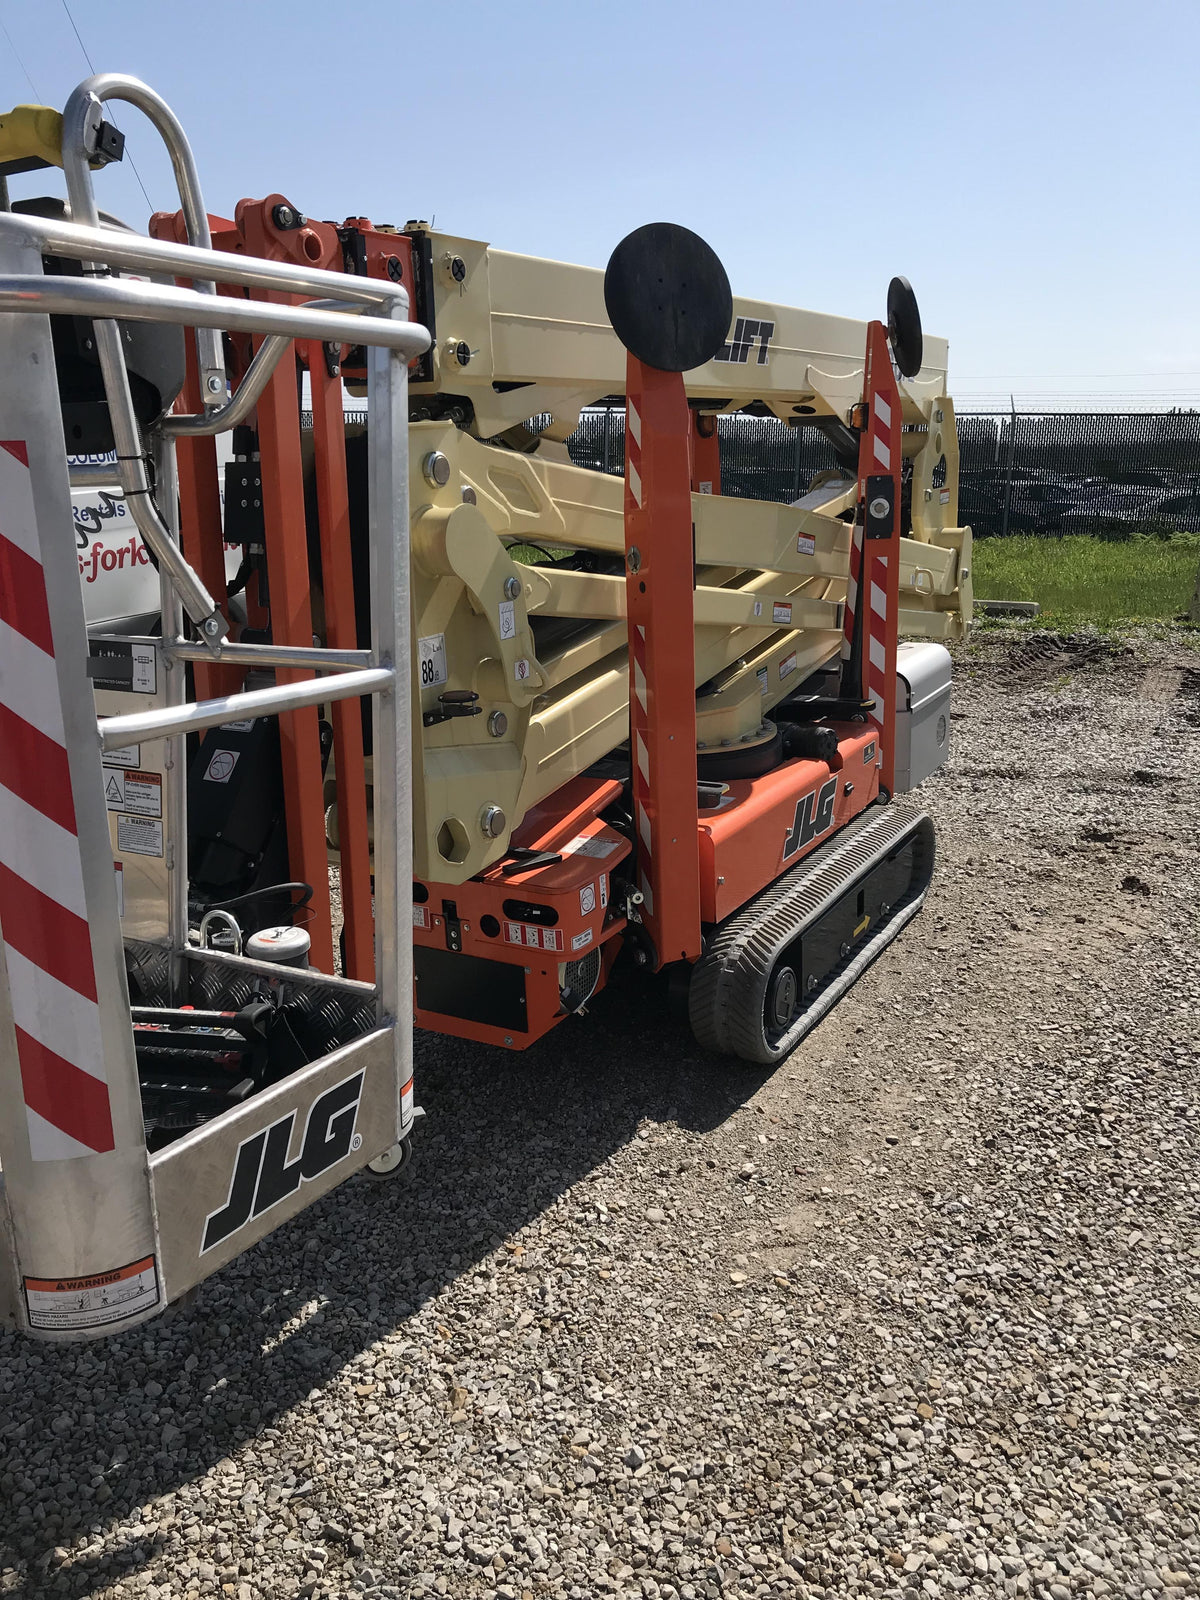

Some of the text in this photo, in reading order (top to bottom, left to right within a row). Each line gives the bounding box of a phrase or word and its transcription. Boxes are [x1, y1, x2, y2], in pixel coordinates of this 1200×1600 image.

[422, 658, 434, 684] 88
[131, 773, 160, 784] WARNING
[783, 775, 838, 862] JLG
[199, 1066, 367, 1258] JLG
[67, 1273, 121, 1290] WARNING
